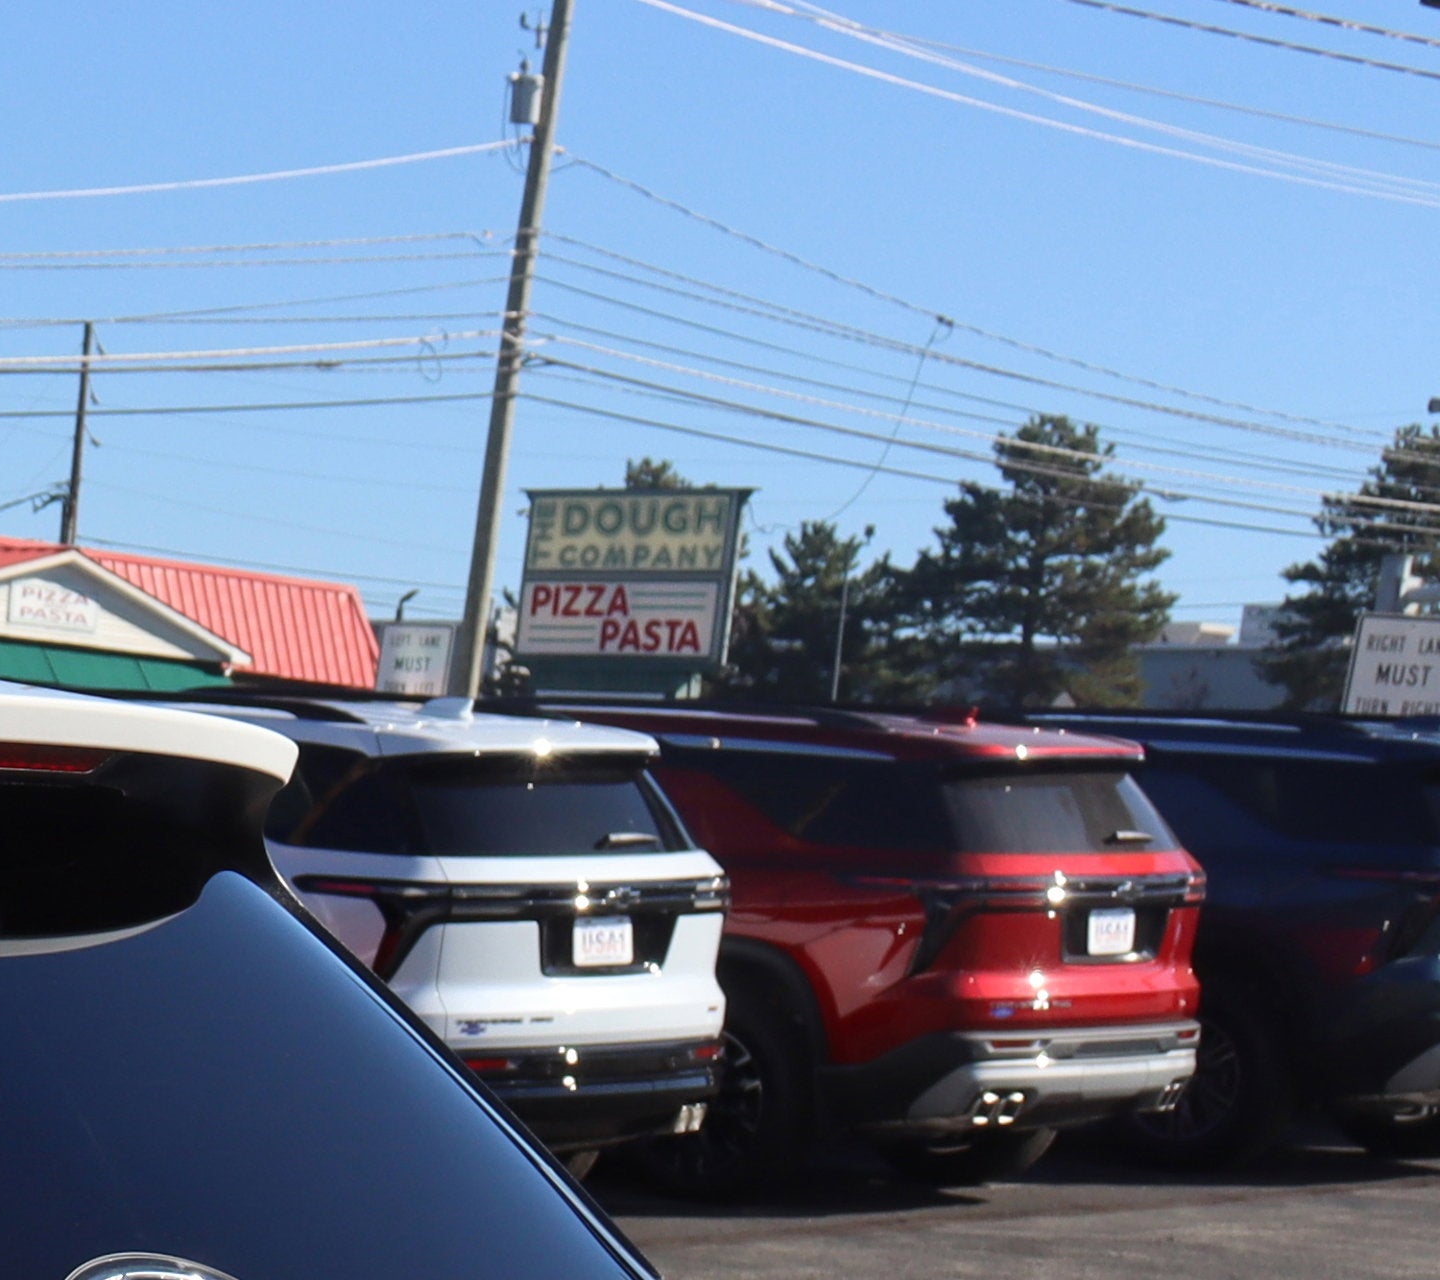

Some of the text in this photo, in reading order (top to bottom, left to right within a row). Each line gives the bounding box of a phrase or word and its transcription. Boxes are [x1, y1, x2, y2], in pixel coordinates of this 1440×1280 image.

[562, 501, 723, 536] DOUGH
[559, 544, 721, 568] COMPANY
[22, 585, 89, 605] PIZZA
[530, 584, 630, 617] PIZZA
[20, 606, 87, 624] PASTA
[599, 619, 700, 652] PASTA
[1366, 633, 1440, 654] RIGHT LAN
[393, 656, 431, 672] MUST
[1375, 662, 1433, 687] MUST
